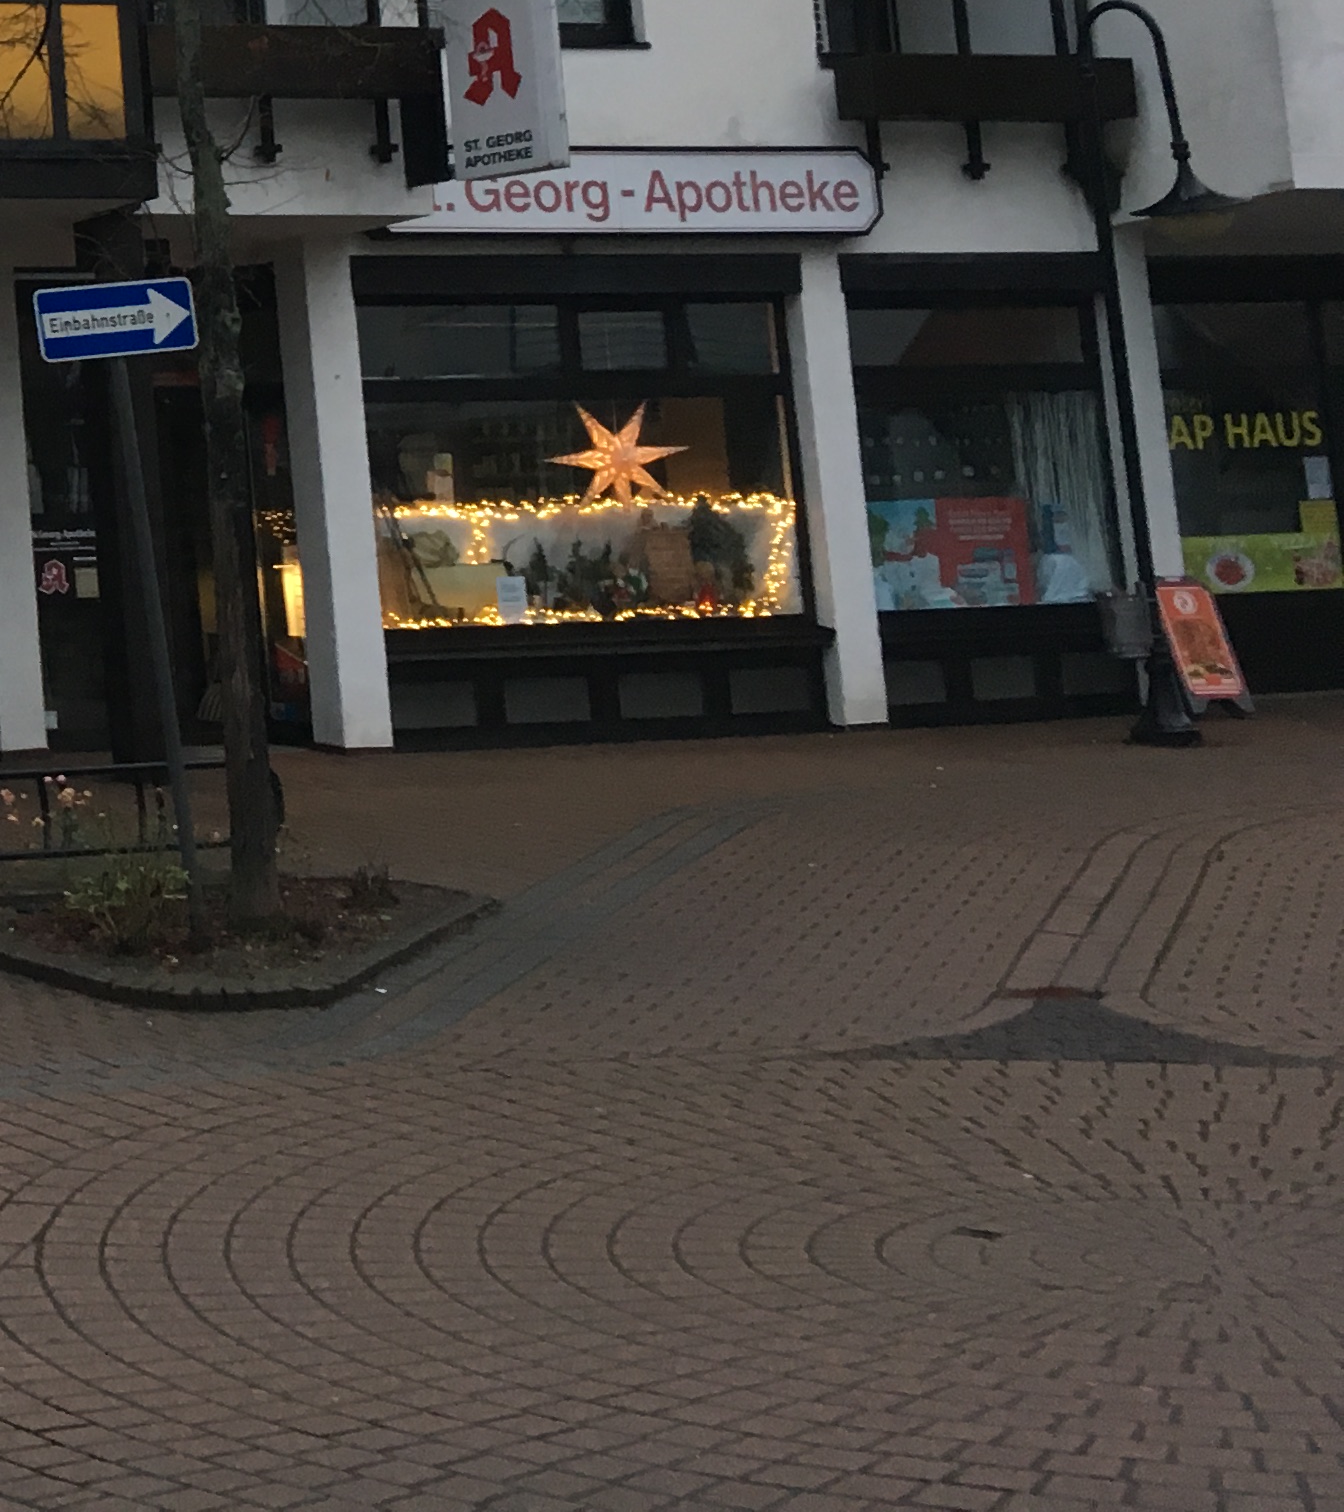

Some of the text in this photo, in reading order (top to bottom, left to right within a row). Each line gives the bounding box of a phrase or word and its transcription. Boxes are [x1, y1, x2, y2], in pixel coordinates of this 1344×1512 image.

[463, 130, 532, 152] ST. GEORG
[465, 146, 533, 169] APOTHEKE
[645, 169, 859, 221] Apotheke
[48, 309, 154, 334] Einbahnstraße
[1224, 410, 1324, 449] HAUS
